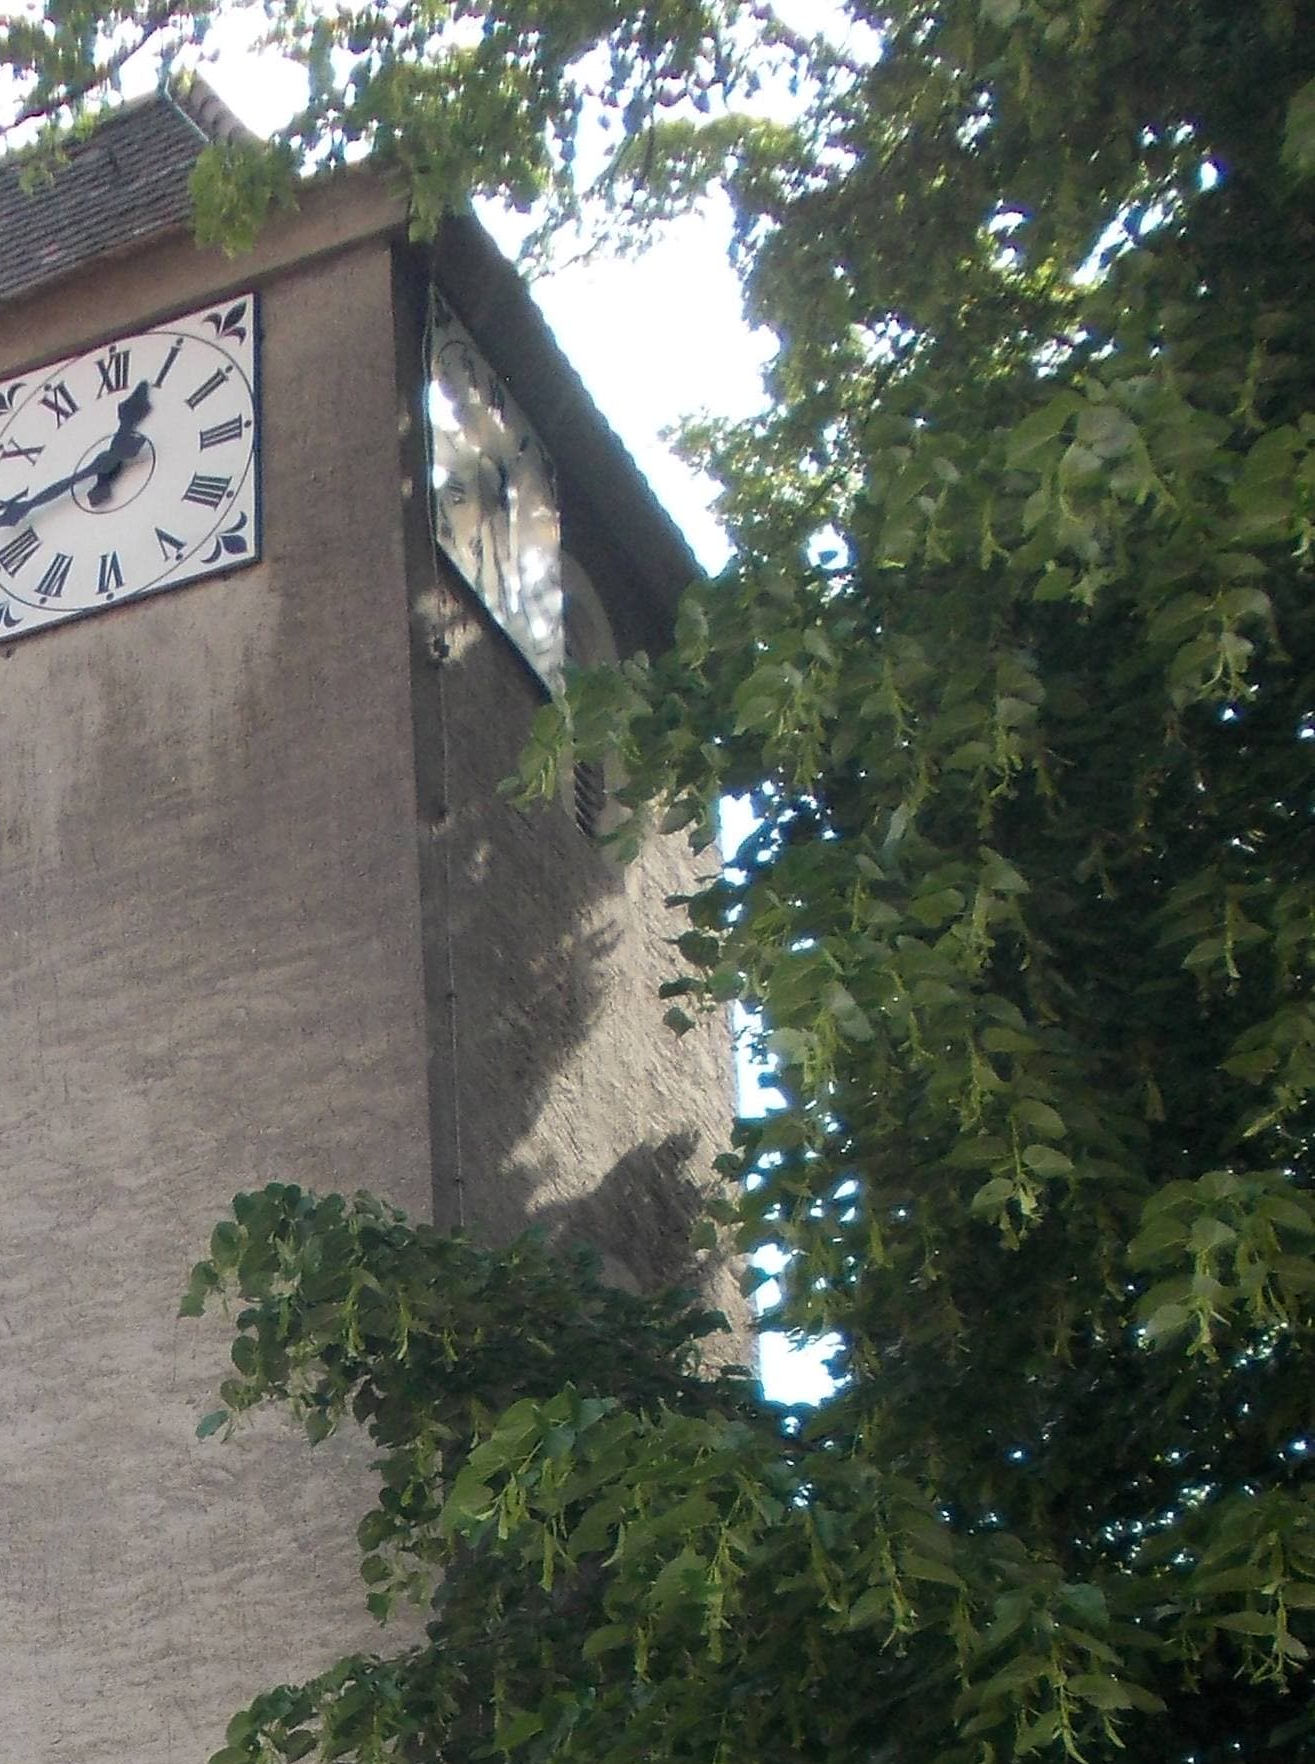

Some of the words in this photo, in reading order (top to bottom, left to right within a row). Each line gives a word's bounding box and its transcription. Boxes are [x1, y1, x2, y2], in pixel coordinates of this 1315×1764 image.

[96, 350, 131, 399] XII
[186, 371, 227, 410] II
[39, 382, 80, 429] XI
[0, 438, 45, 466] X
[199, 414, 243, 452] III
[182, 472, 232, 510] IIII
[155, 527, 185, 561] V
[36, 553, 73, 597] VII
[97, 551, 124, 594] VI
